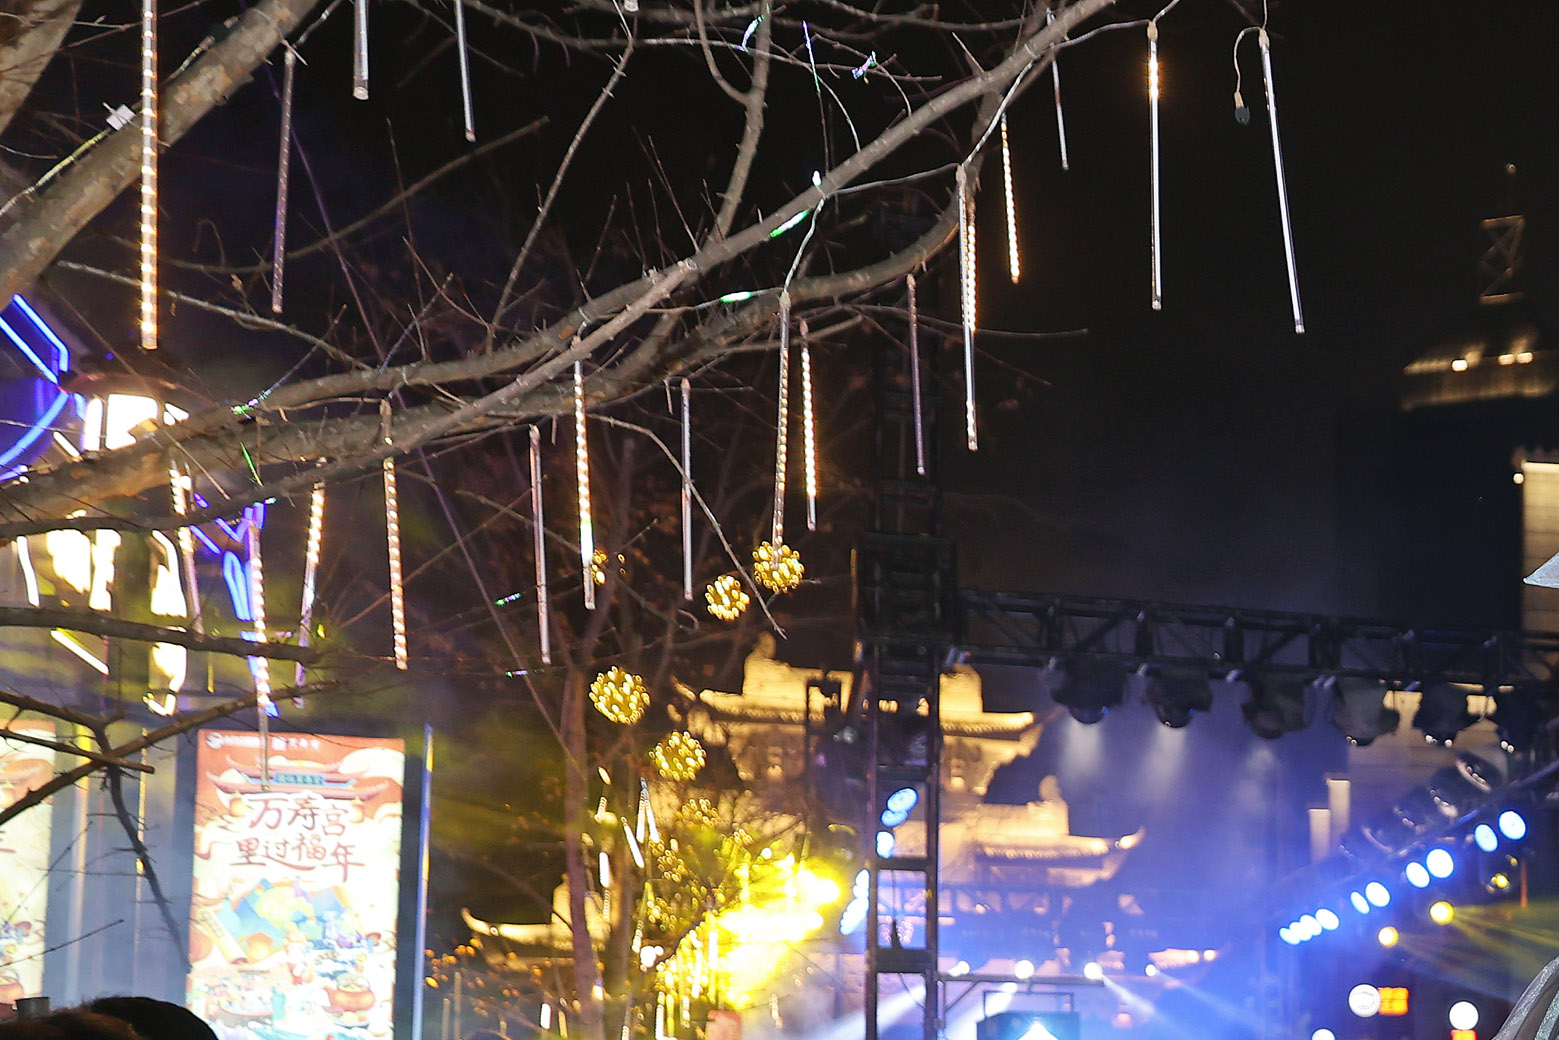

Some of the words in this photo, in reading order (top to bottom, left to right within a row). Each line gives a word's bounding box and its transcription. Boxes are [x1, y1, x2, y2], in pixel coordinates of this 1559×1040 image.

[247, 795, 348, 836] 万寿宫
[230, 833, 365, 882] 里过福年
